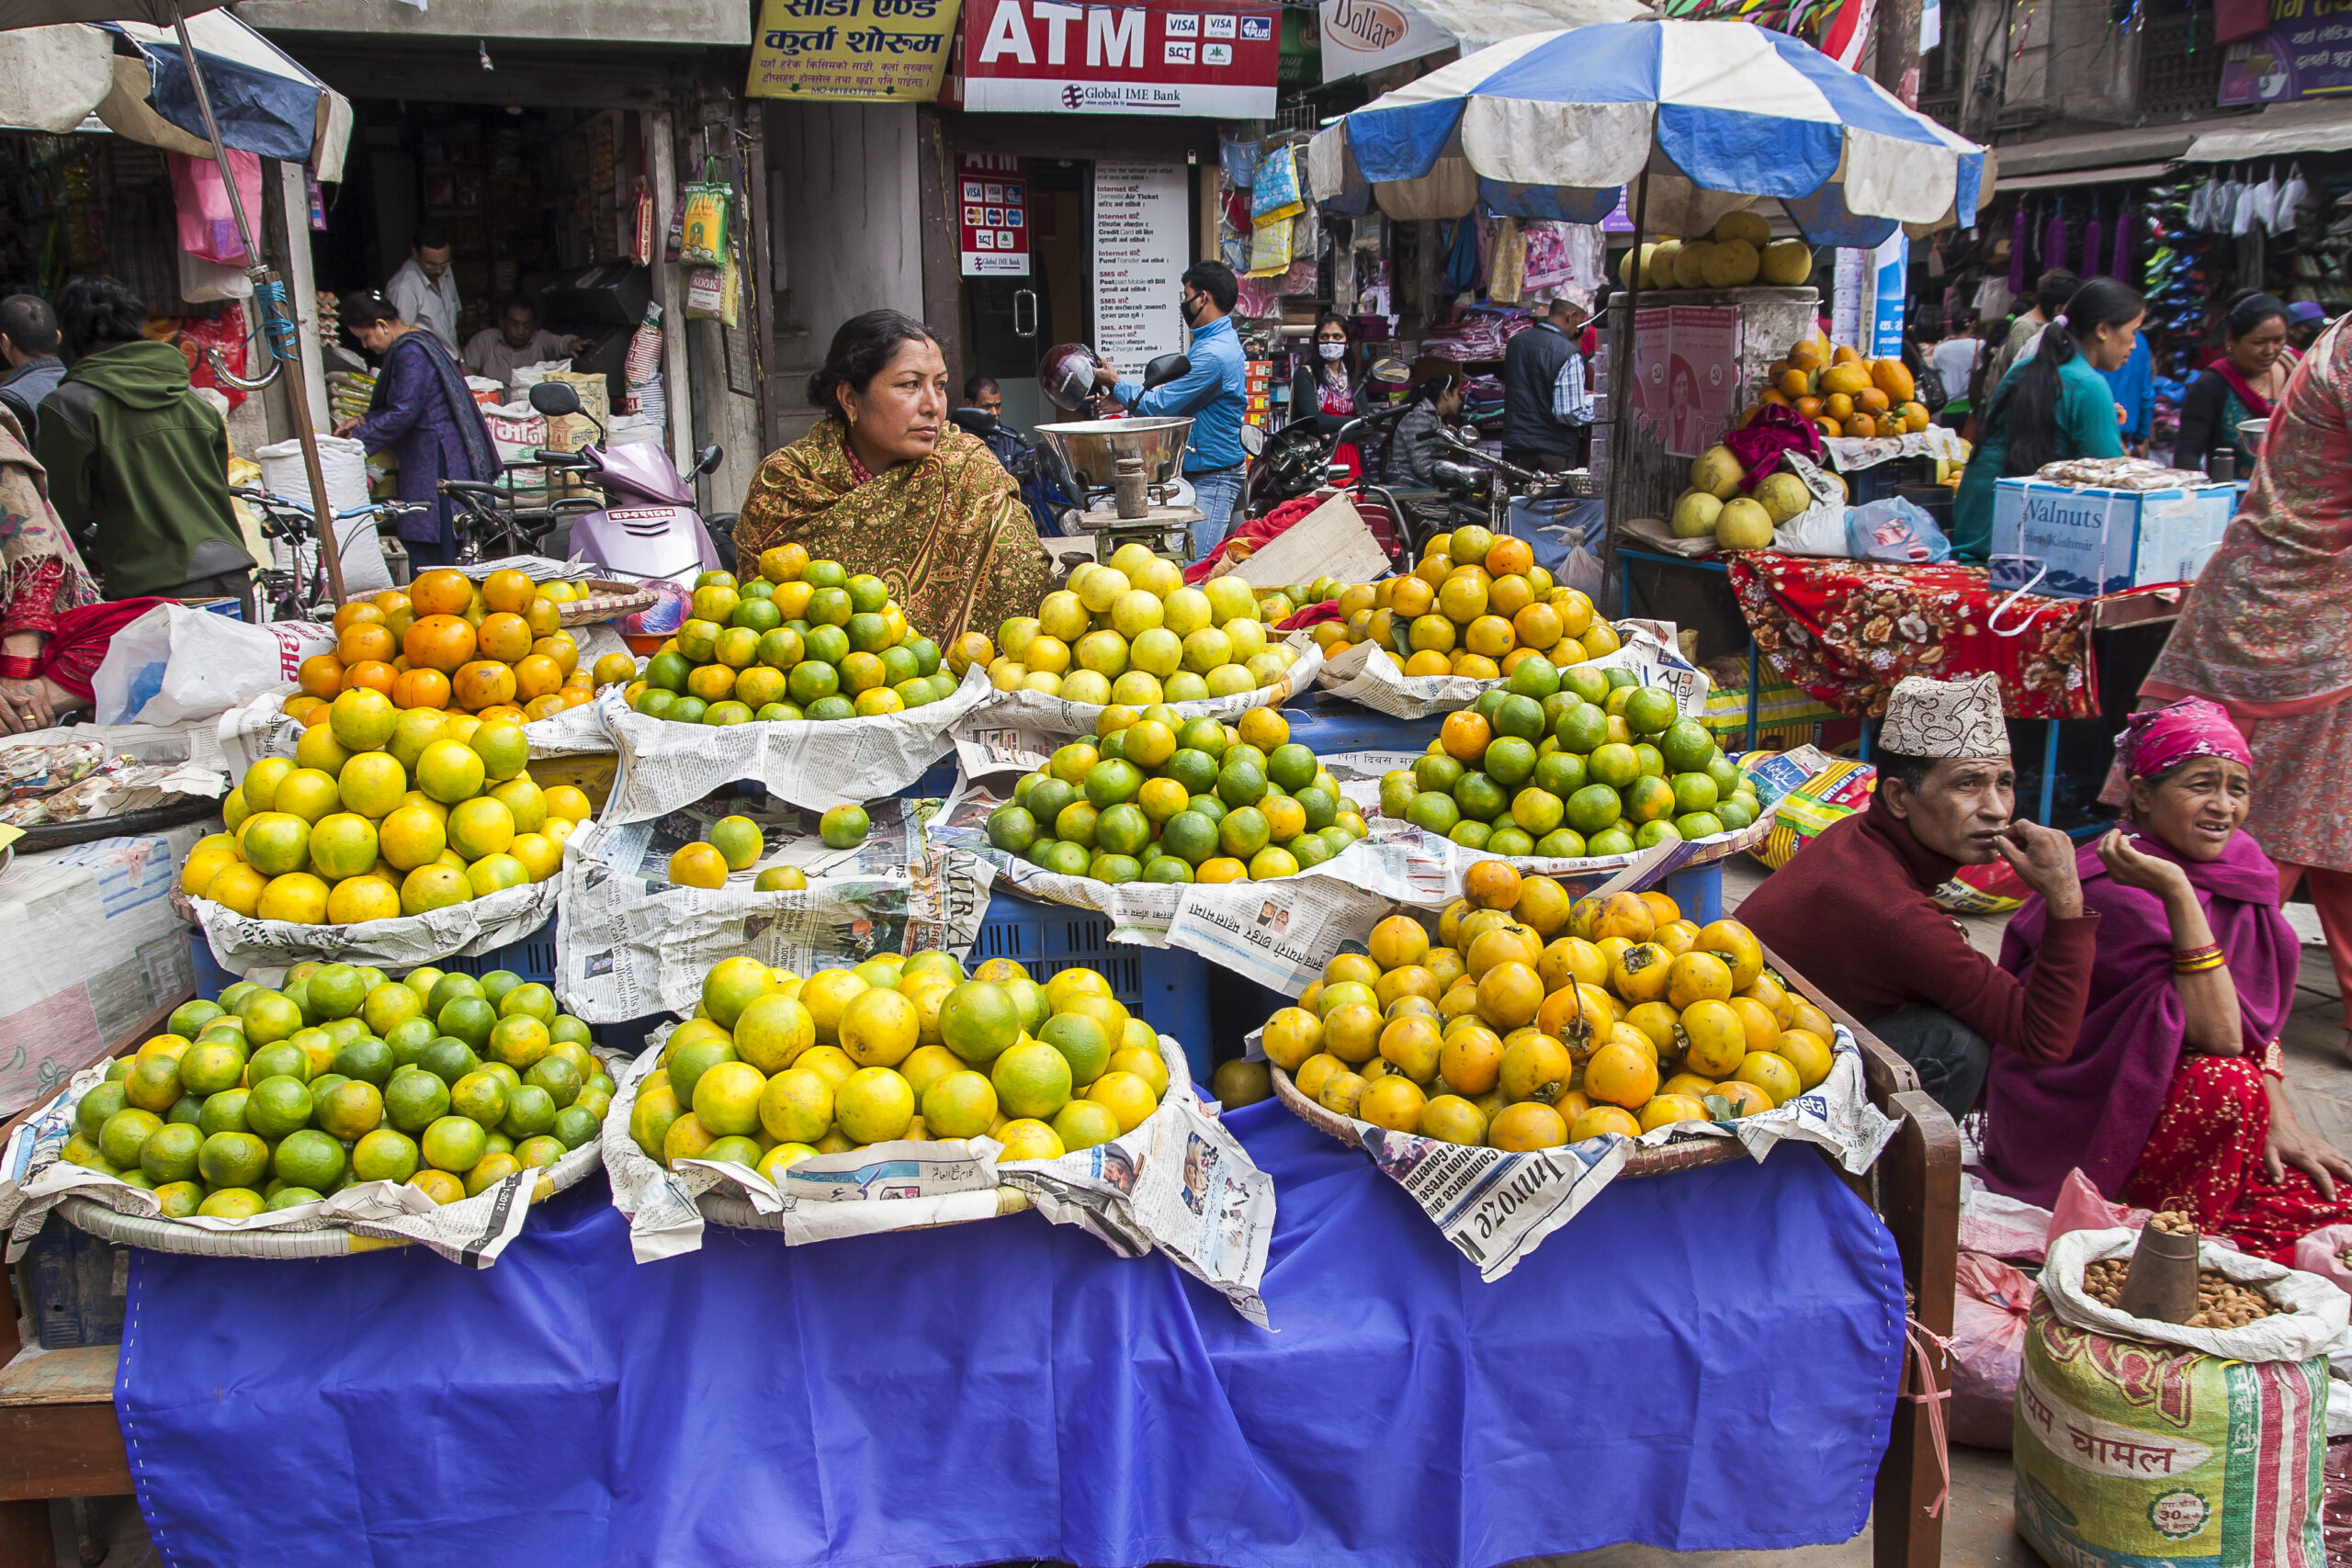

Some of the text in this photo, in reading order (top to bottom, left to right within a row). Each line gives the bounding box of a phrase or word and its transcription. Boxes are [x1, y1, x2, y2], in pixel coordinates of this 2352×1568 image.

[978, 0, 1146, 68] ATM
[1170, 19, 1195, 31] VISA
[1210, 18, 1231, 28] VISA
[1334, 0, 1395, 49] Dollar
[1169, 47, 1192, 57] SCT
[1085, 87, 1181, 101] Global IME Bank
[966, 186, 980, 197] VISA
[983, 256, 997, 265] Global
[2022, 499, 2103, 530] Walnuts
[1448, 1151, 1499, 1201] Commerce
[1474, 1151, 1566, 1240] Imroze
[2066, 1425, 2177, 1473] चामल
